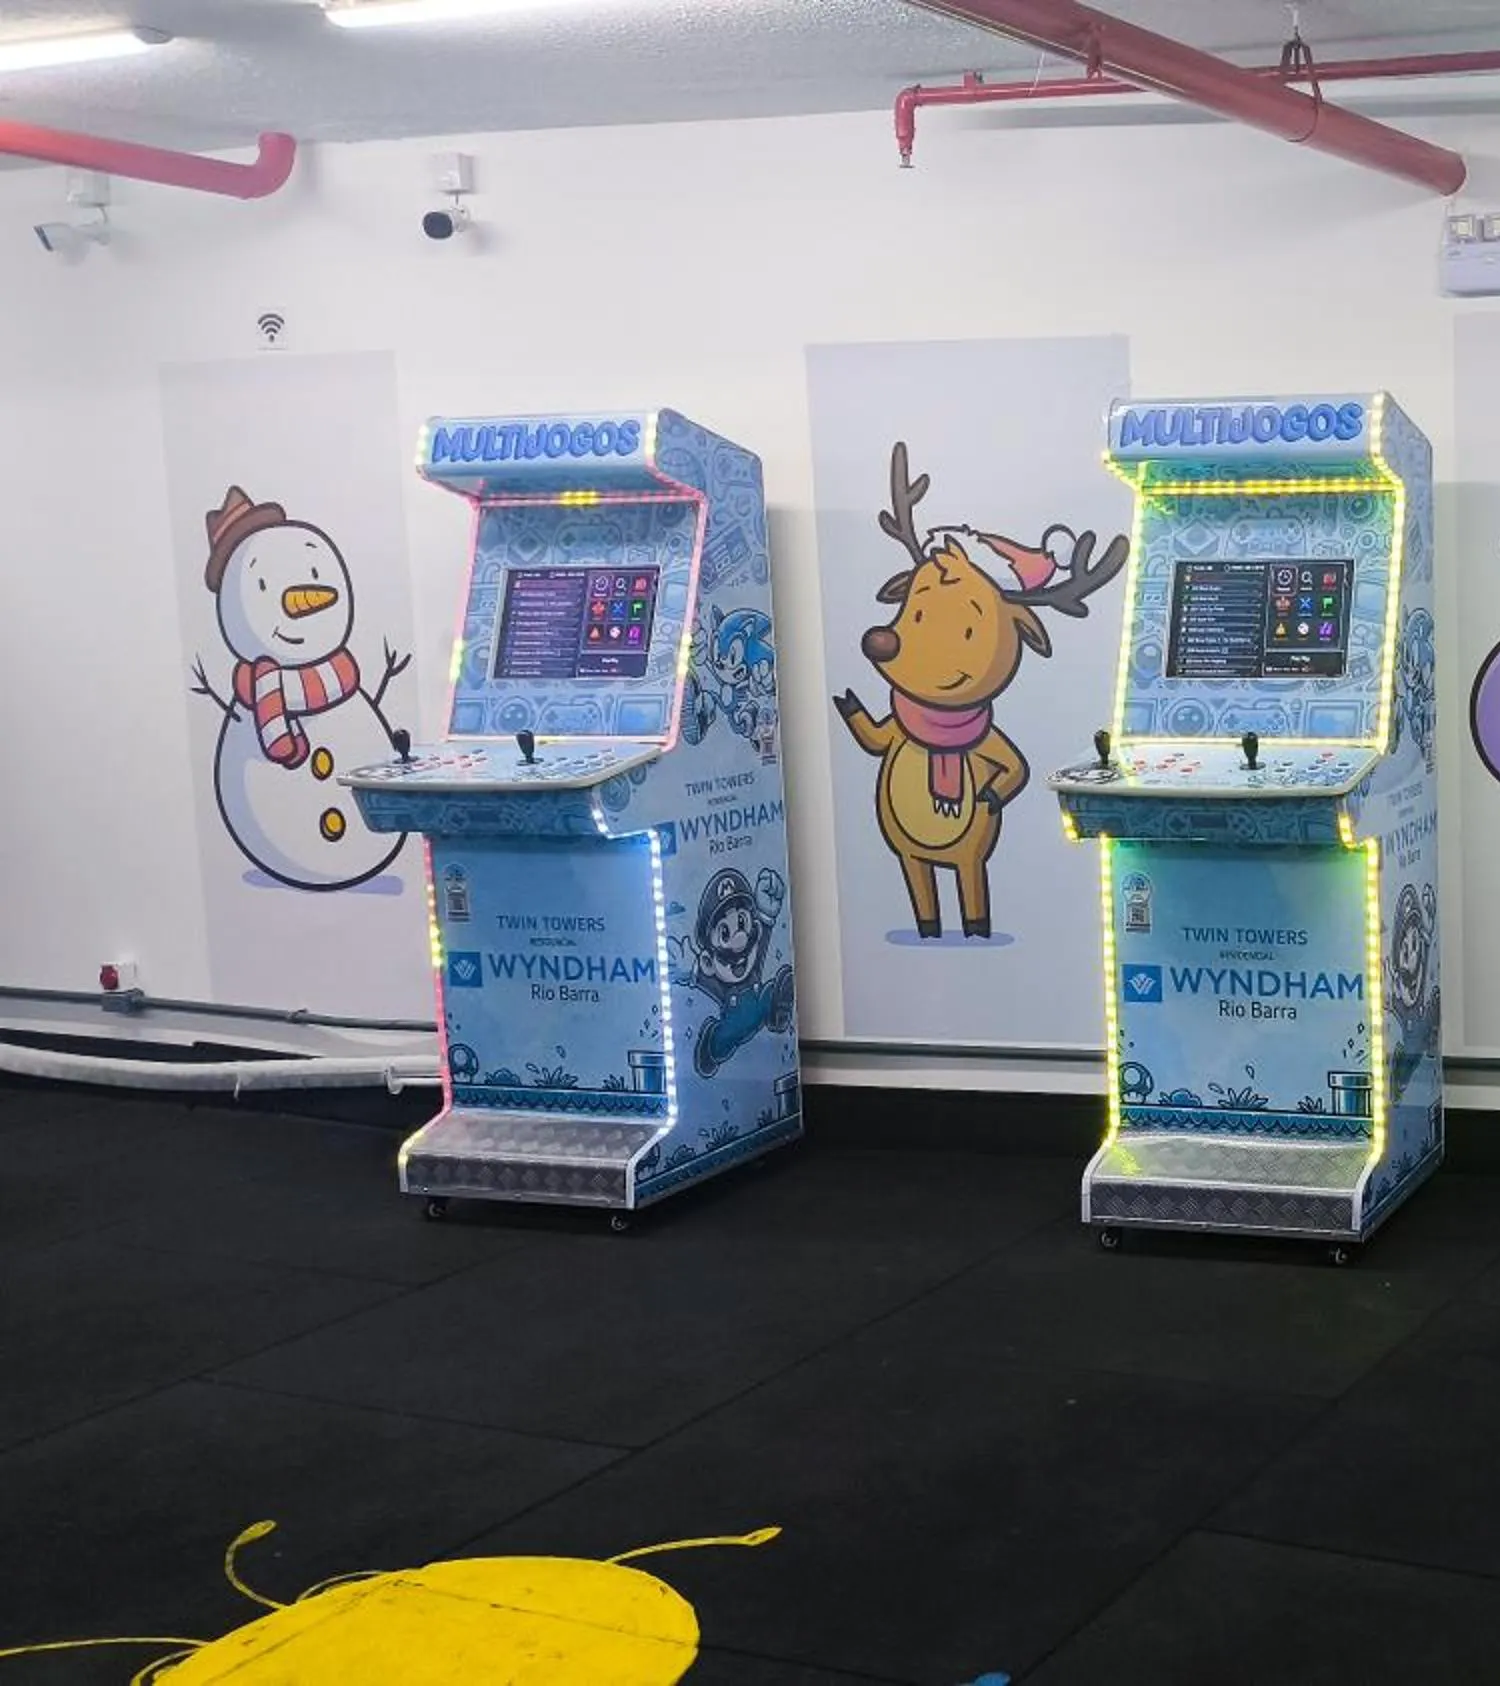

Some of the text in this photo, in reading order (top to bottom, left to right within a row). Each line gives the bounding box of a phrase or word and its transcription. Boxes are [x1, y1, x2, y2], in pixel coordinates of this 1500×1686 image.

[1119, 401, 1364, 449] MULTIJOGOS
[431, 419, 641, 464] MULTIJOGOS
[679, 800, 785, 843] WYNDHAM
[495, 914, 605, 933] TWIN TOWERS
[1181, 927, 1309, 946] TWIN TOWERS
[487, 953, 656, 983] WYNDHAM
[530, 983, 600, 1003] Rio Barra
[1169, 966, 1365, 1001] WYNDHAM
[1218, 1000, 1298, 1020] Rio Barra
